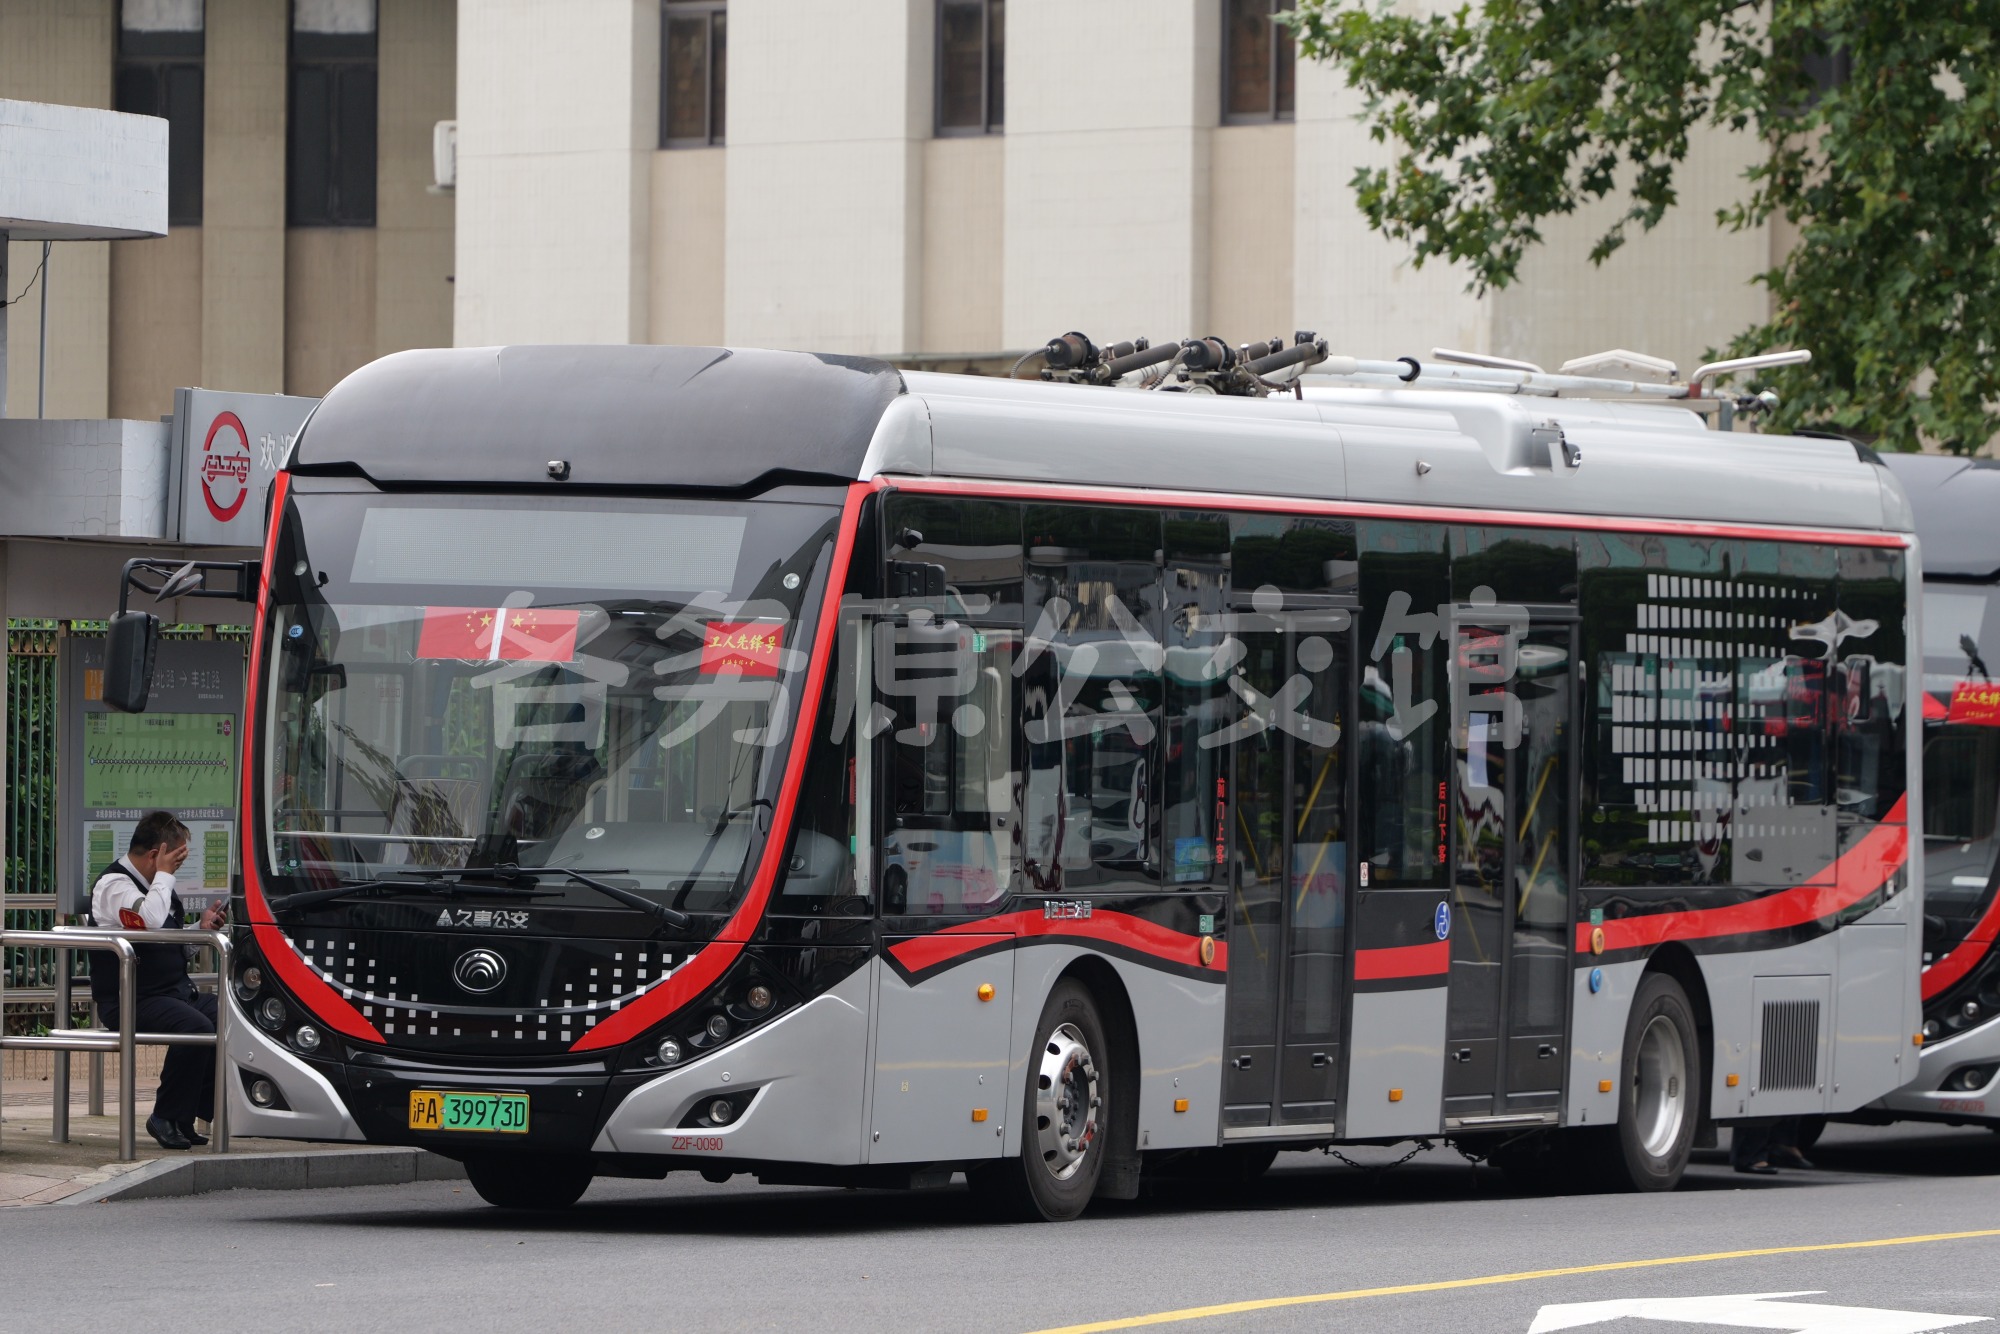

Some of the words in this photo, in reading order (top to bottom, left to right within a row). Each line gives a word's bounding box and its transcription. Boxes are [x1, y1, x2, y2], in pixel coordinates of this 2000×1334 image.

[708, 634, 776, 654] 工人先锋号
[1216, 777, 1226, 865] 前门上客
[1438, 781, 1447, 864] 后门下客
[412, 1098, 438, 1124] 沪A
[449, 1099, 526, 1127] 39973D
[672, 1136, 723, 1151] Z2F-0090
